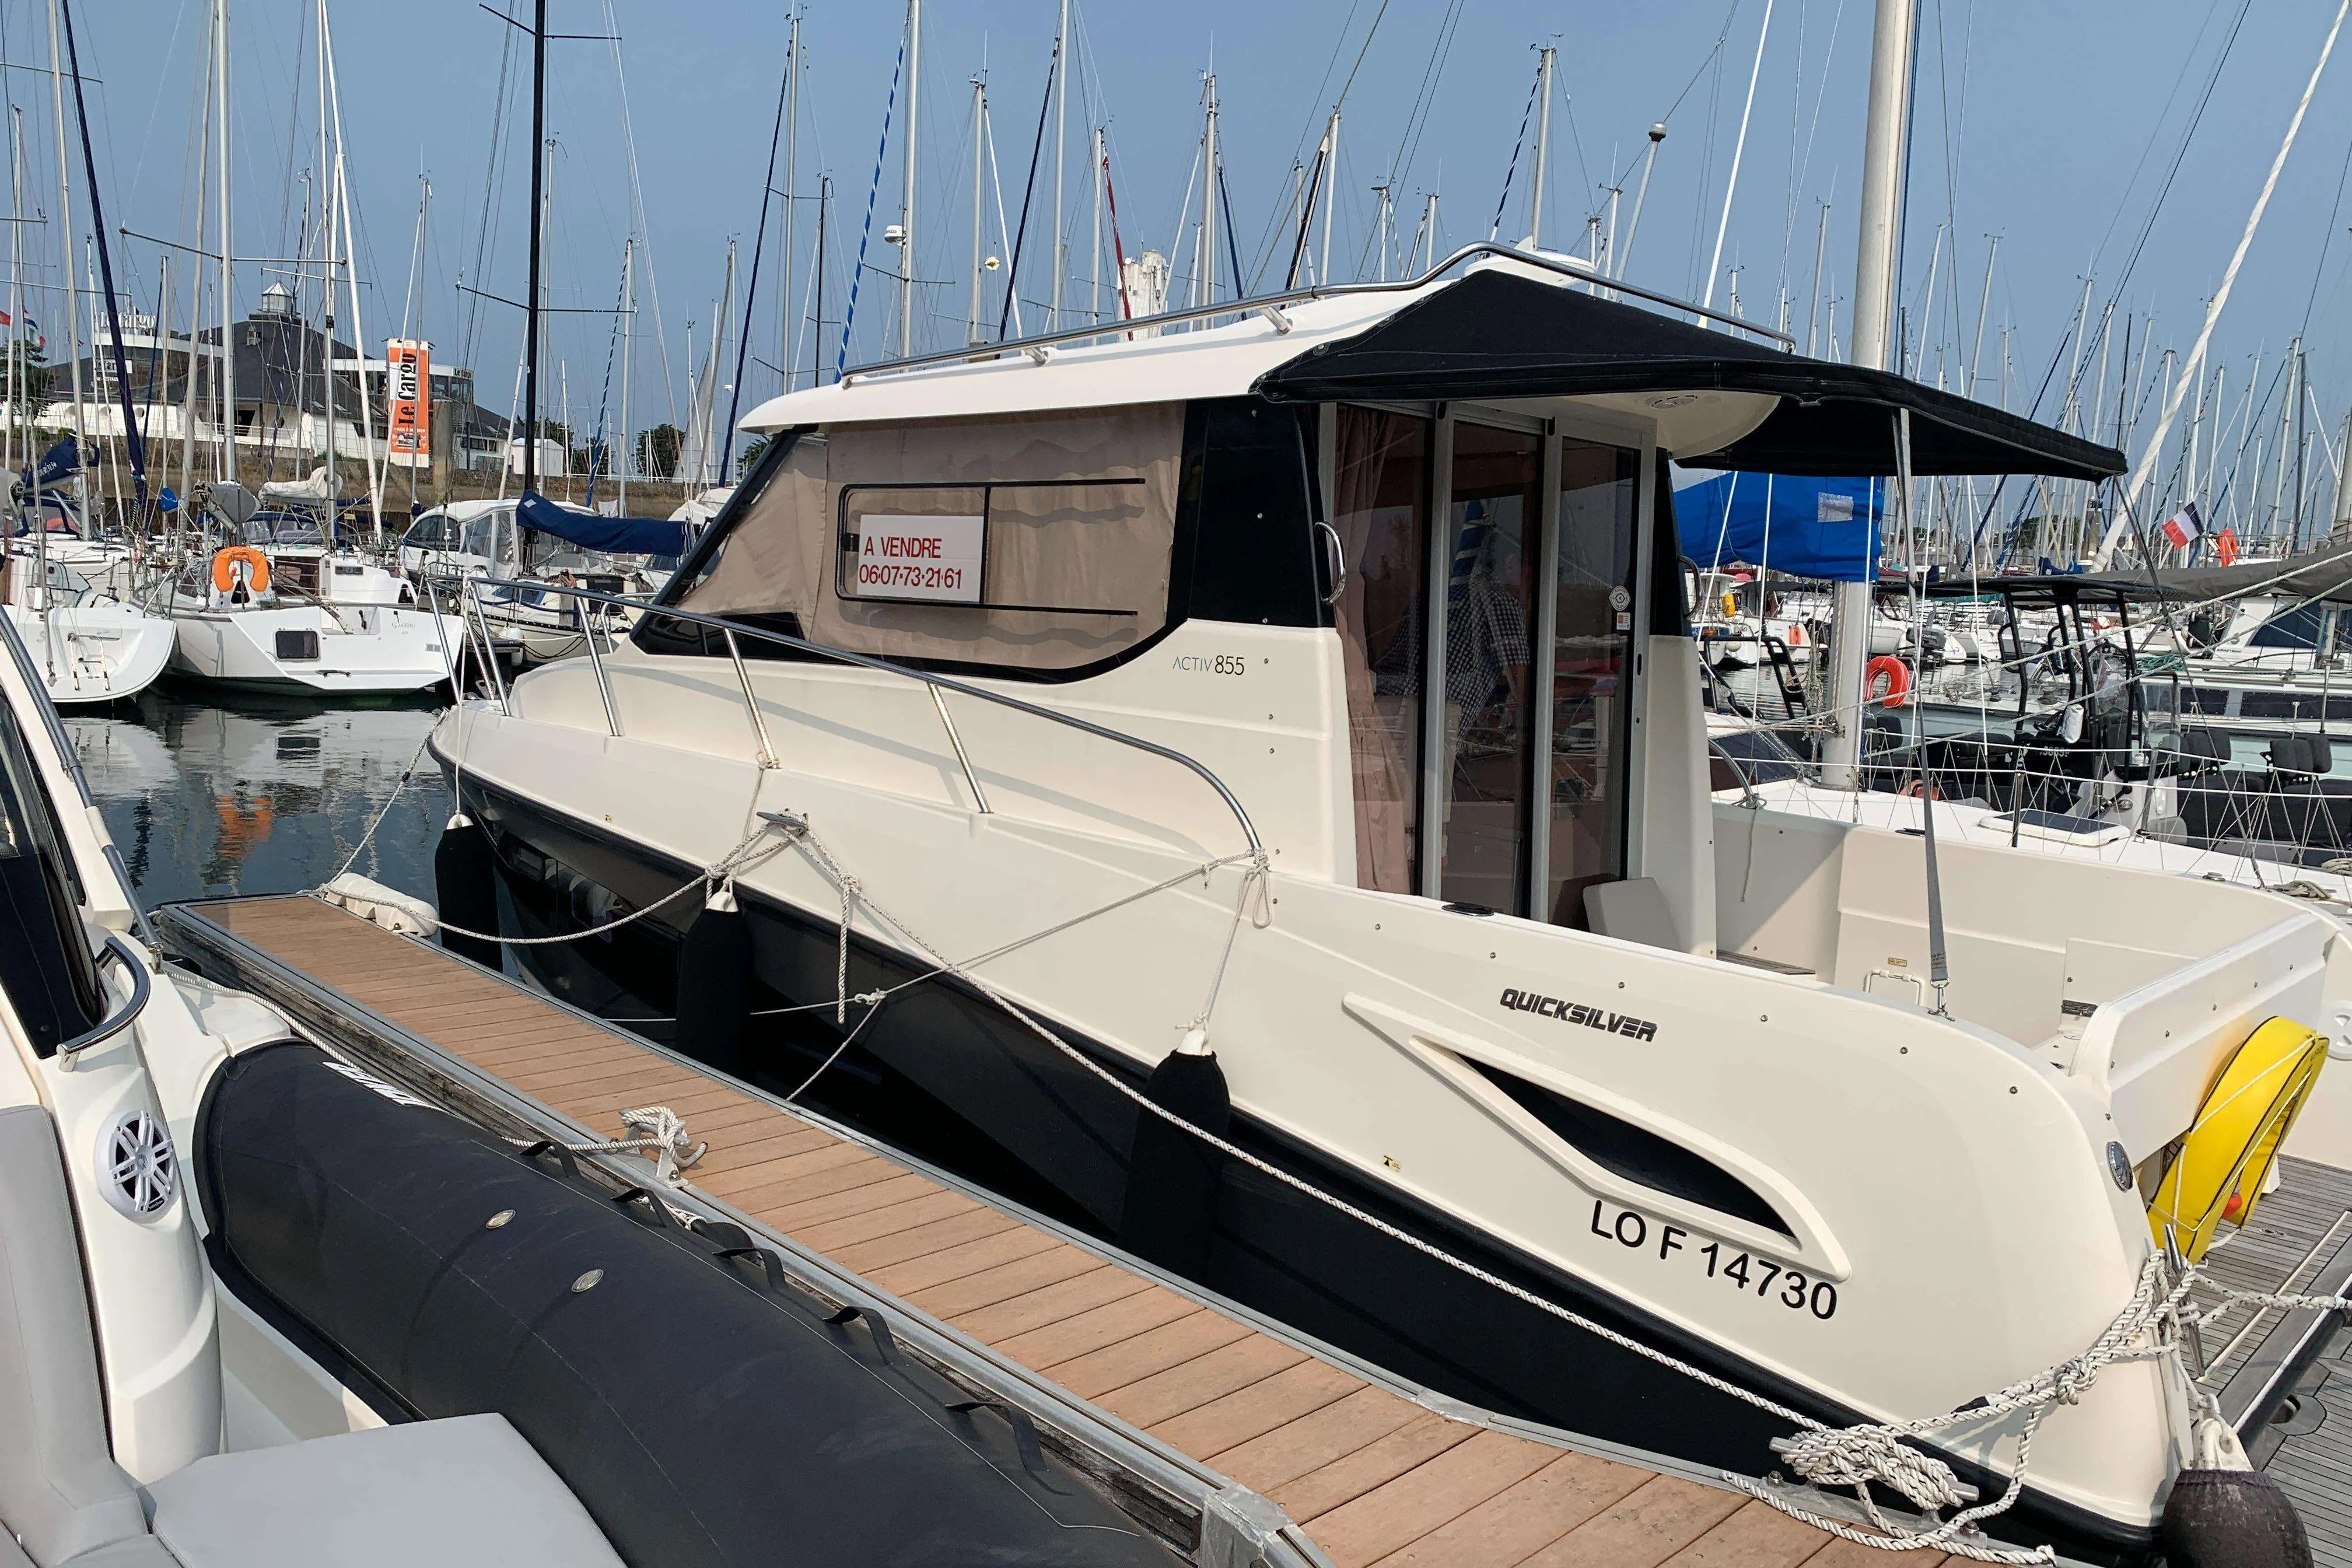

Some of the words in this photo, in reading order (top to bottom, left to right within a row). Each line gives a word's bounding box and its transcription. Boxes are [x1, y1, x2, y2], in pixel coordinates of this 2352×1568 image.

[118, 312, 156, 330] Cargo
[398, 352, 417, 400] Cargo
[398, 405, 415, 424] Le
[864, 536, 874, 555] A
[881, 536, 942, 558] VENDRE
[1500, 988, 1658, 1042] QUICKSILVER
[1591, 1200, 1646, 1248] LO
[1660, 1225, 1687, 1259] F
[1701, 1242, 1838, 1320] 14730
